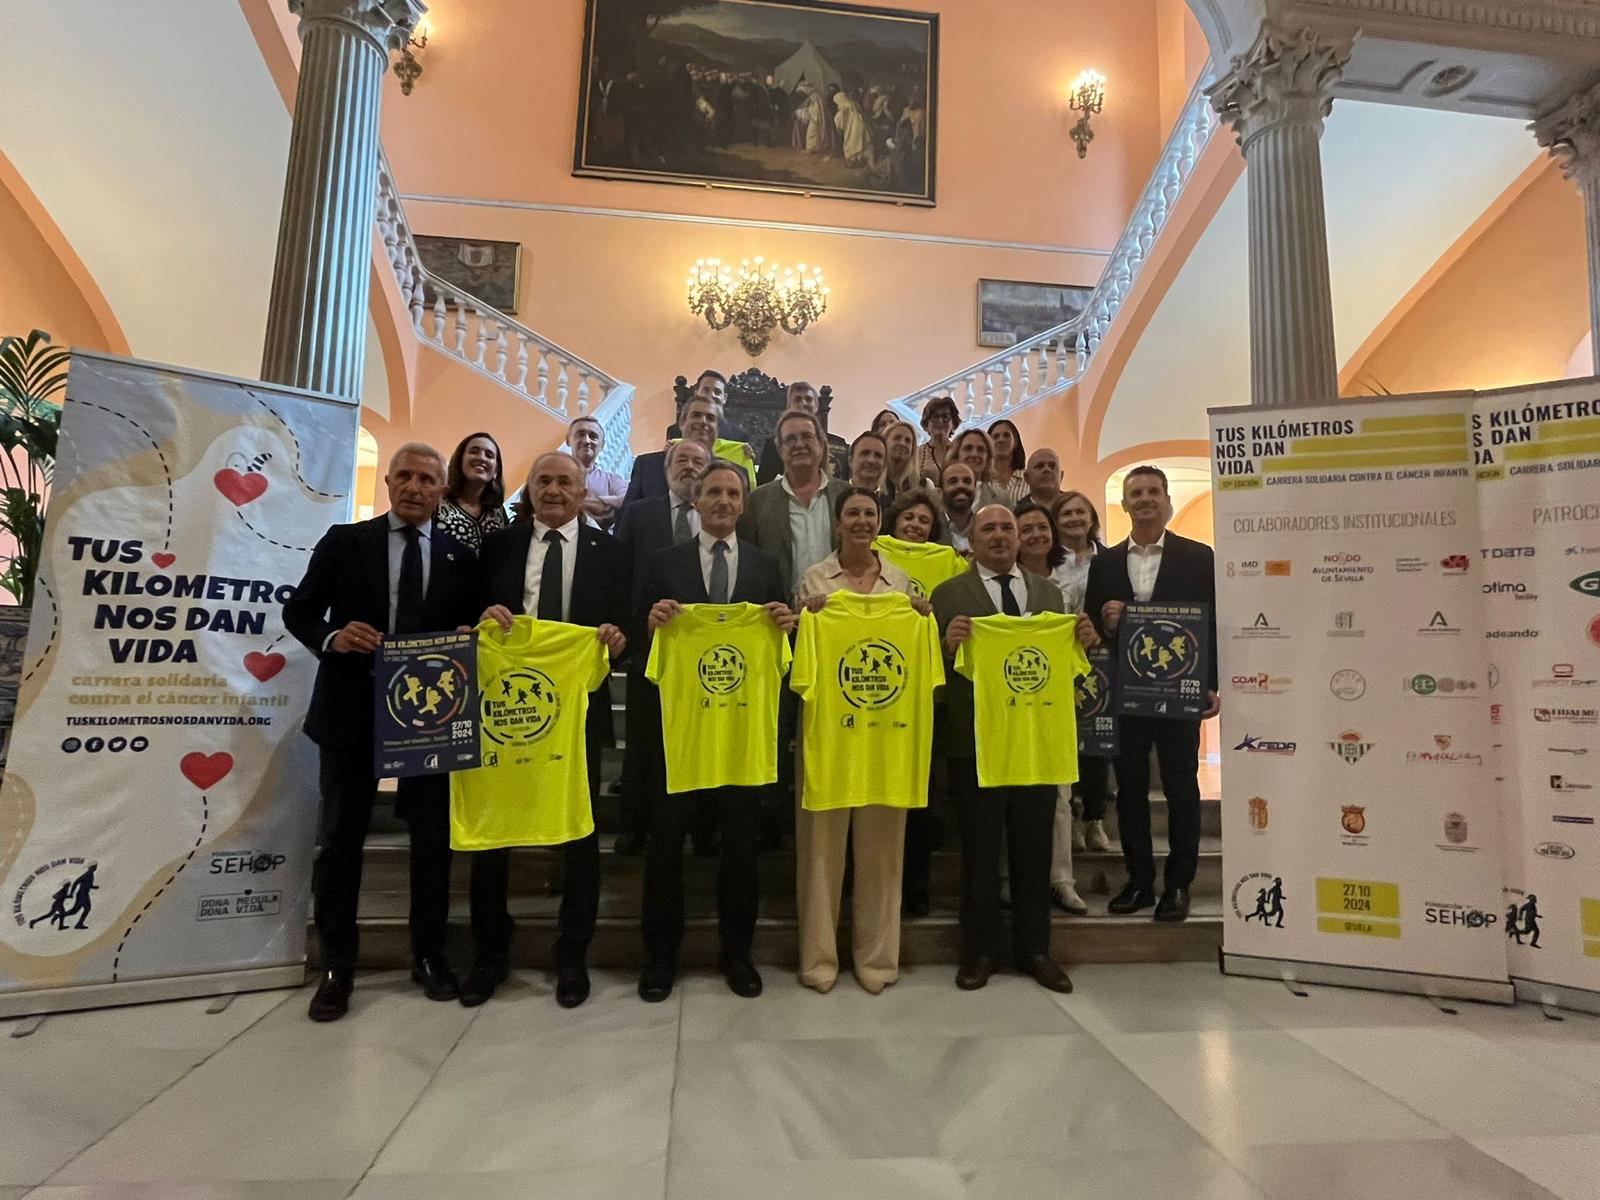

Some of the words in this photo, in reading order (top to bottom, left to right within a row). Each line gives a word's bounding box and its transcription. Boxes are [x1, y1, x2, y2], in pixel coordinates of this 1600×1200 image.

[1490, 401, 1600, 428] KILÓMETRO
[1216, 427, 1245, 443] TUS
[1252, 420, 1354, 440] KILÓMETROS
[1491, 426, 1531, 446] DAN
[1216, 444, 1246, 459] NOS
[1252, 441, 1285, 457] DAN
[1217, 460, 1254, 475] VIDA
[1510, 464, 1554, 476] CARRERA
[1557, 460, 1600, 472] SOLIDAR
[1266, 475, 1303, 486] CARRERA
[1305, 474, 1347, 485] SOLIDARIA
[1349, 472, 1383, 483] CONTRA
[1384, 471, 1394, 481] EL
[1396, 468, 1431, 480] CÁNCER
[1433, 467, 1469, 479] INFANTIL
[1533, 504, 1600, 523] PATROCI
[1234, 516, 1339, 533] COLABORADORES
[1343, 511, 1456, 530] INSTITUCIONALES
[67, 536, 144, 564] TUS
[1334, 574, 1365, 583] SEVILLA
[82, 569, 297, 605] KILOMETRO
[94, 604, 177, 631] NOS
[185, 607, 266, 636] DAN
[109, 638, 199, 664] VIDA
[851, 667, 864, 675] TUS
[71, 674, 141, 688] carrera
[146, 674, 228, 688] solidaria
[68, 692, 132, 706] contra
[136, 692, 152, 705] el
[157, 691, 217, 706] cáncer
[222, 693, 289, 707] infantil
[492, 700, 506, 709] TUS
[492, 706, 537, 718] KILÓMETROS
[66, 716, 272, 727] TUSKILOMETROSNOSDANVIDA.ORG
[451, 720, 473, 729] 27/10
[494, 718, 508, 727] NOS
[510, 717, 524, 726] DAN
[526, 715, 542, 724] VIDA
[452, 729, 473, 739] 2024
[1343, 884, 1370, 898] 27.10
[1344, 898, 1370, 911] 2024
